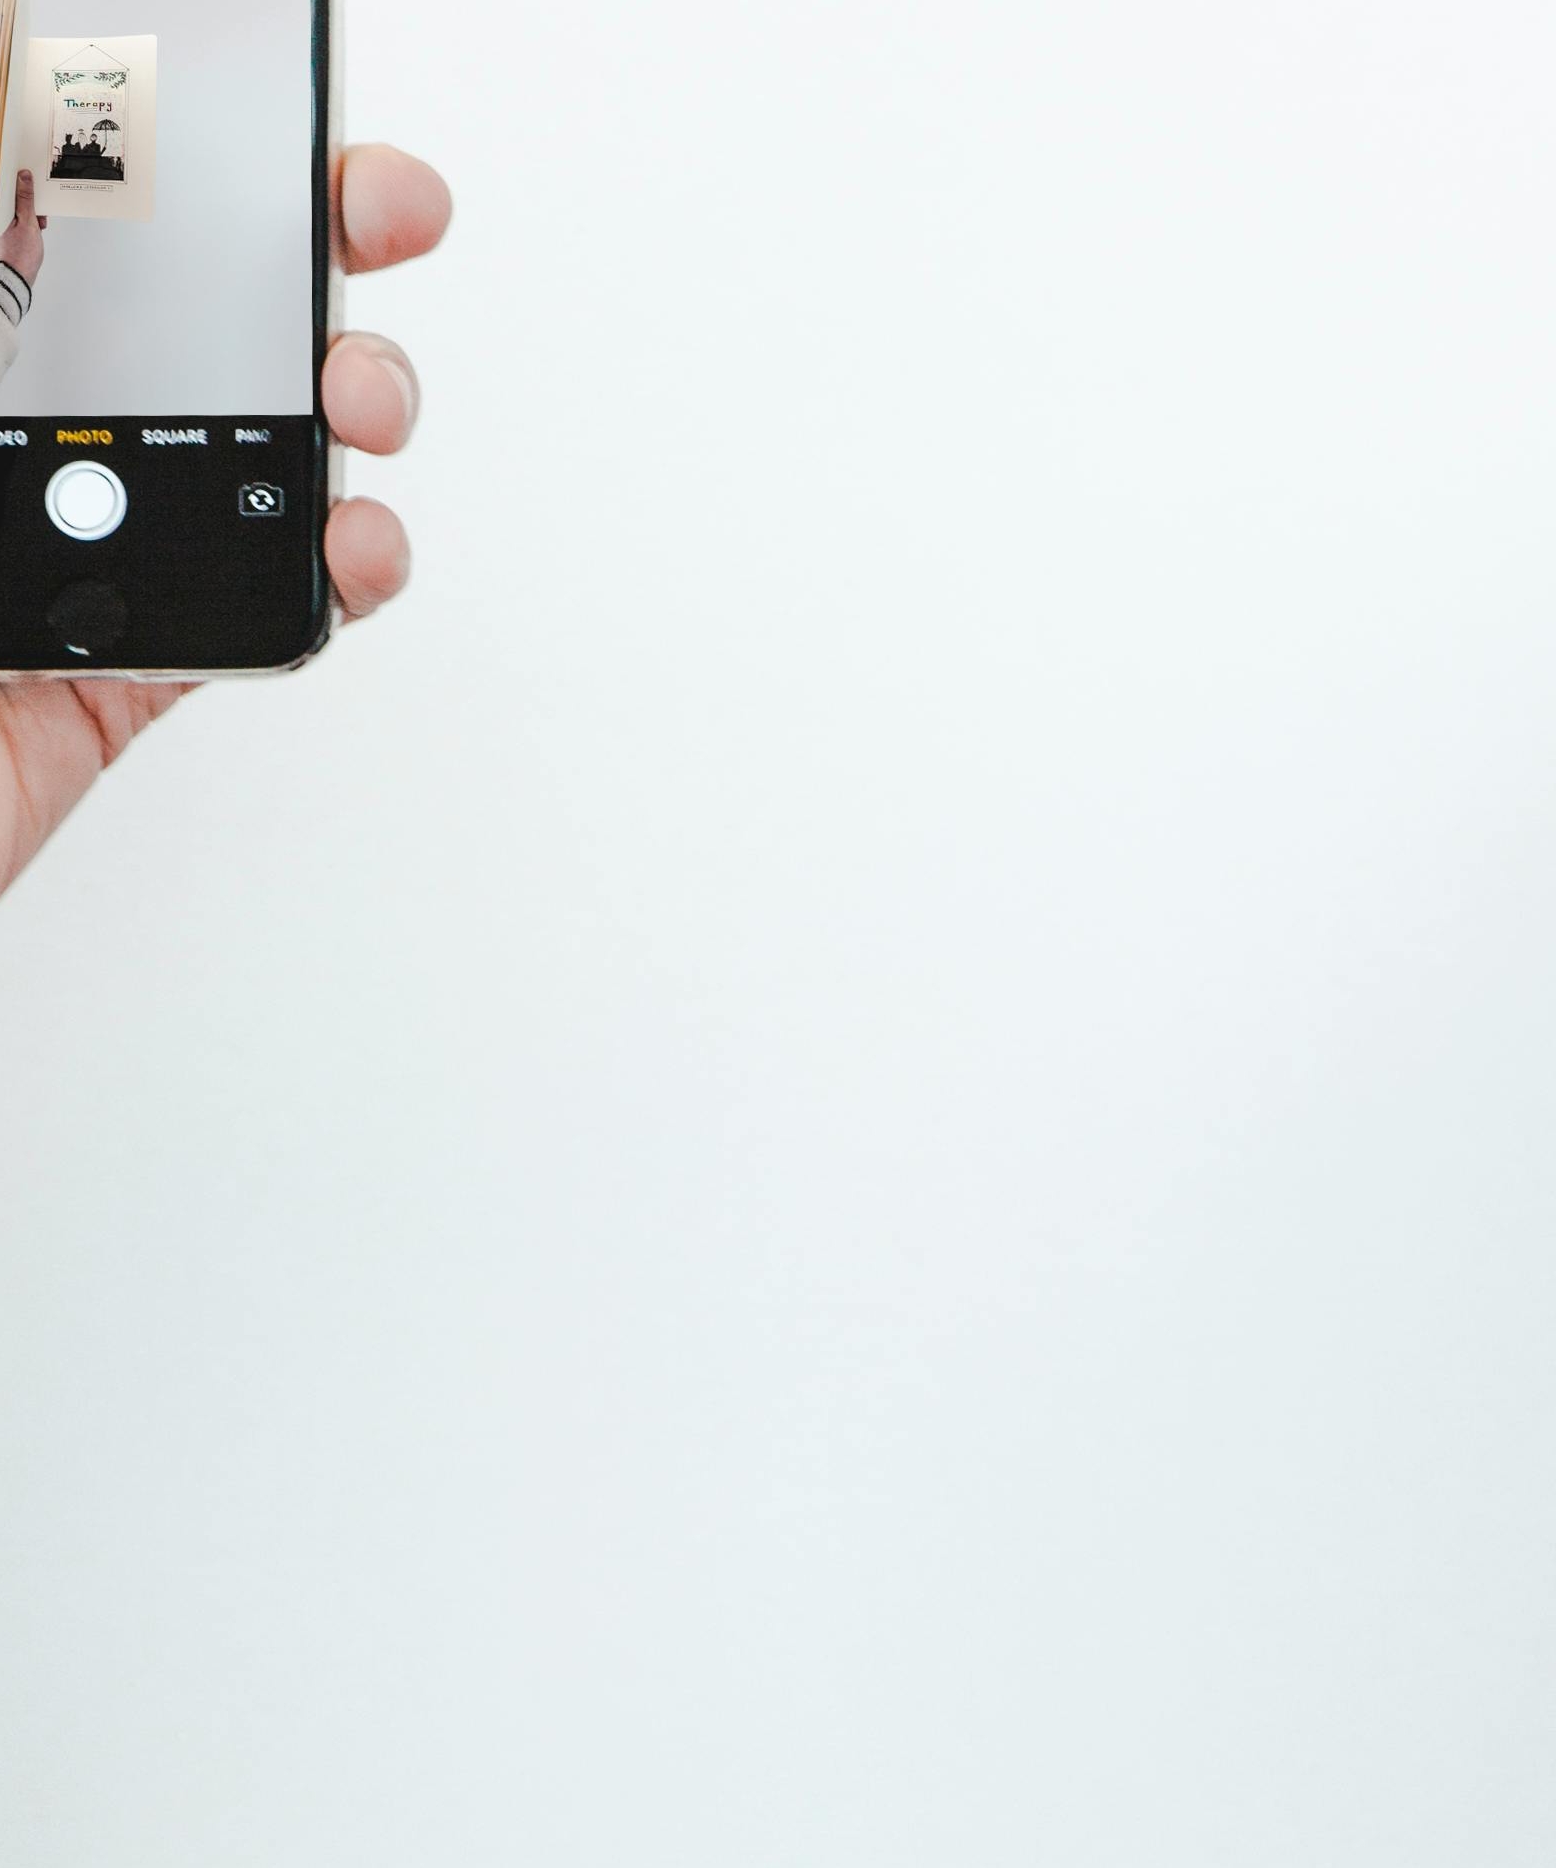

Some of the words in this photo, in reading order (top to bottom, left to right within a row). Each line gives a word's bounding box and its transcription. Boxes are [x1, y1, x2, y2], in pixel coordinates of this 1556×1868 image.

[63, 98, 113, 112] Therapy
[56, 429, 113, 446] PHOTO
[141, 429, 208, 446] SQUARE
